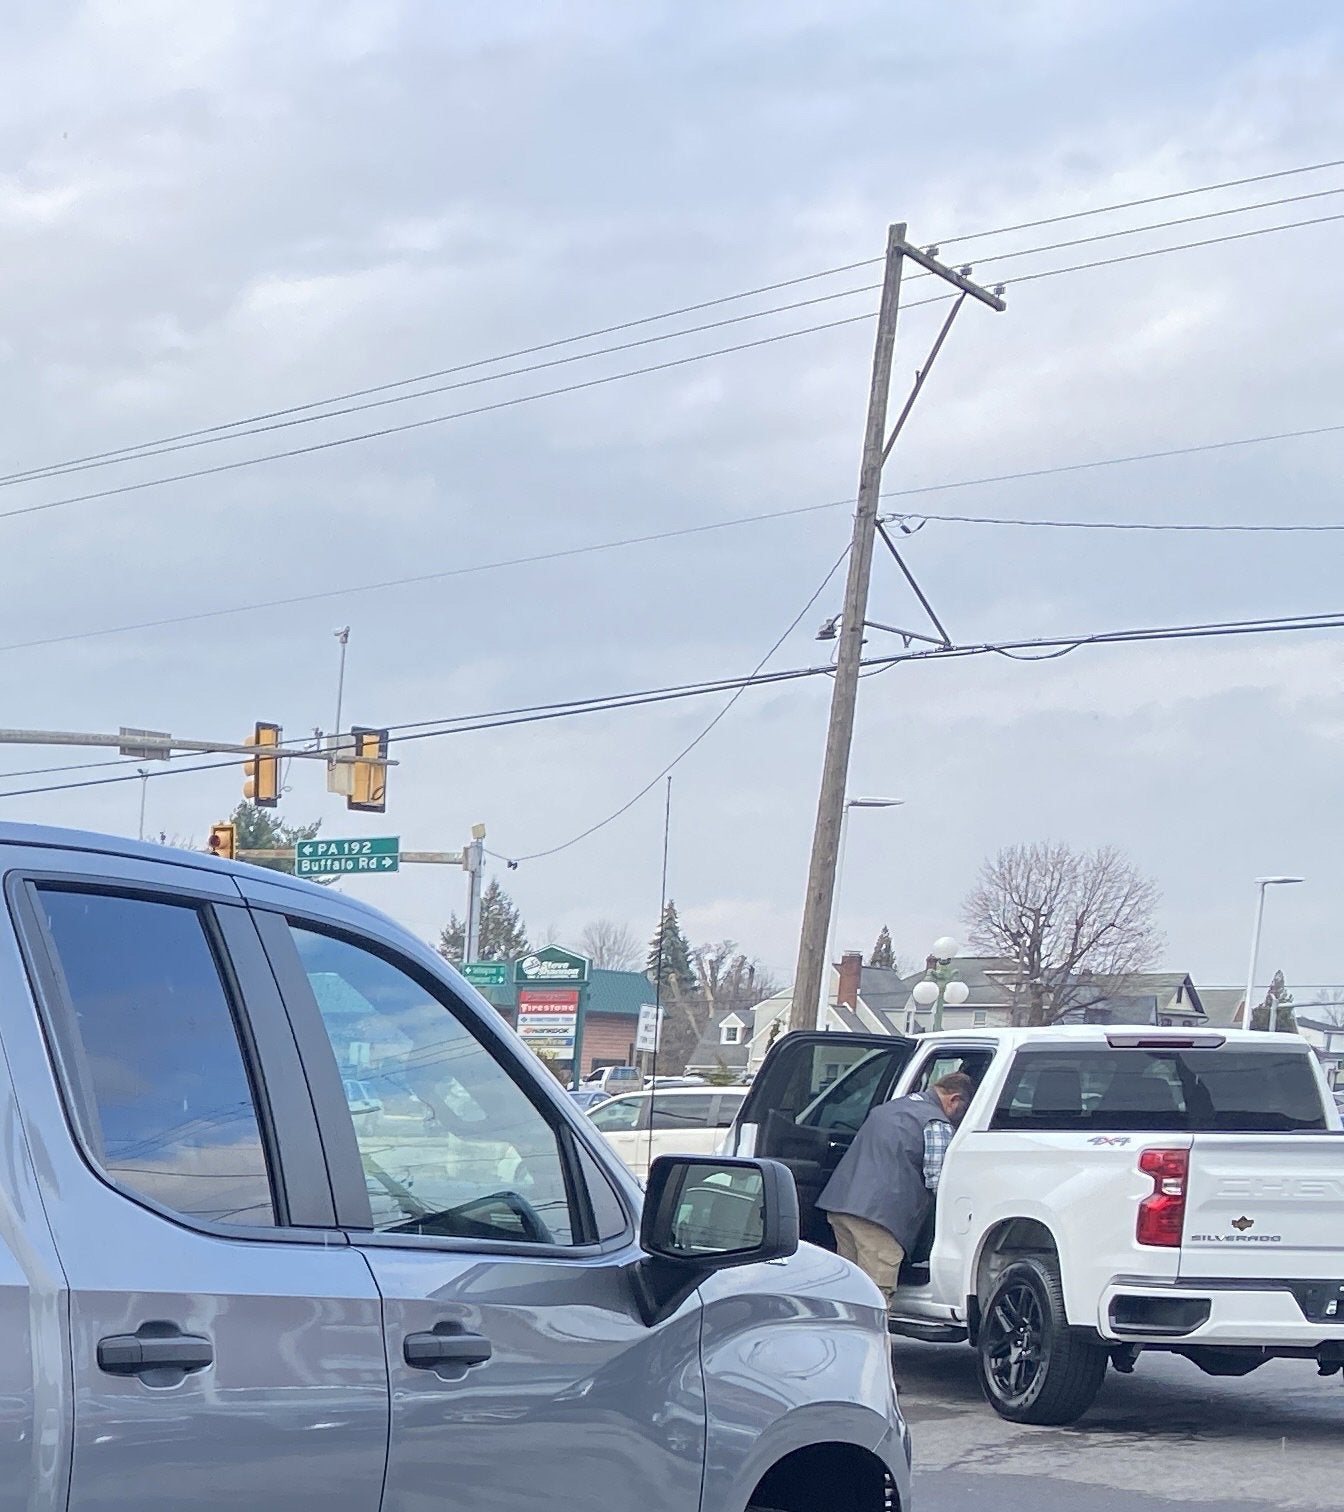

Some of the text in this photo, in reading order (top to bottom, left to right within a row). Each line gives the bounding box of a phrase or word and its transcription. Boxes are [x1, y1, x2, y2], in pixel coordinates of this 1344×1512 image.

[317, 841, 373, 856] PA 192
[301, 856, 378, 872] Buffalo Rd
[520, 1003, 575, 1013] Firestone
[1191, 1234, 1281, 1242] SILVERADO
